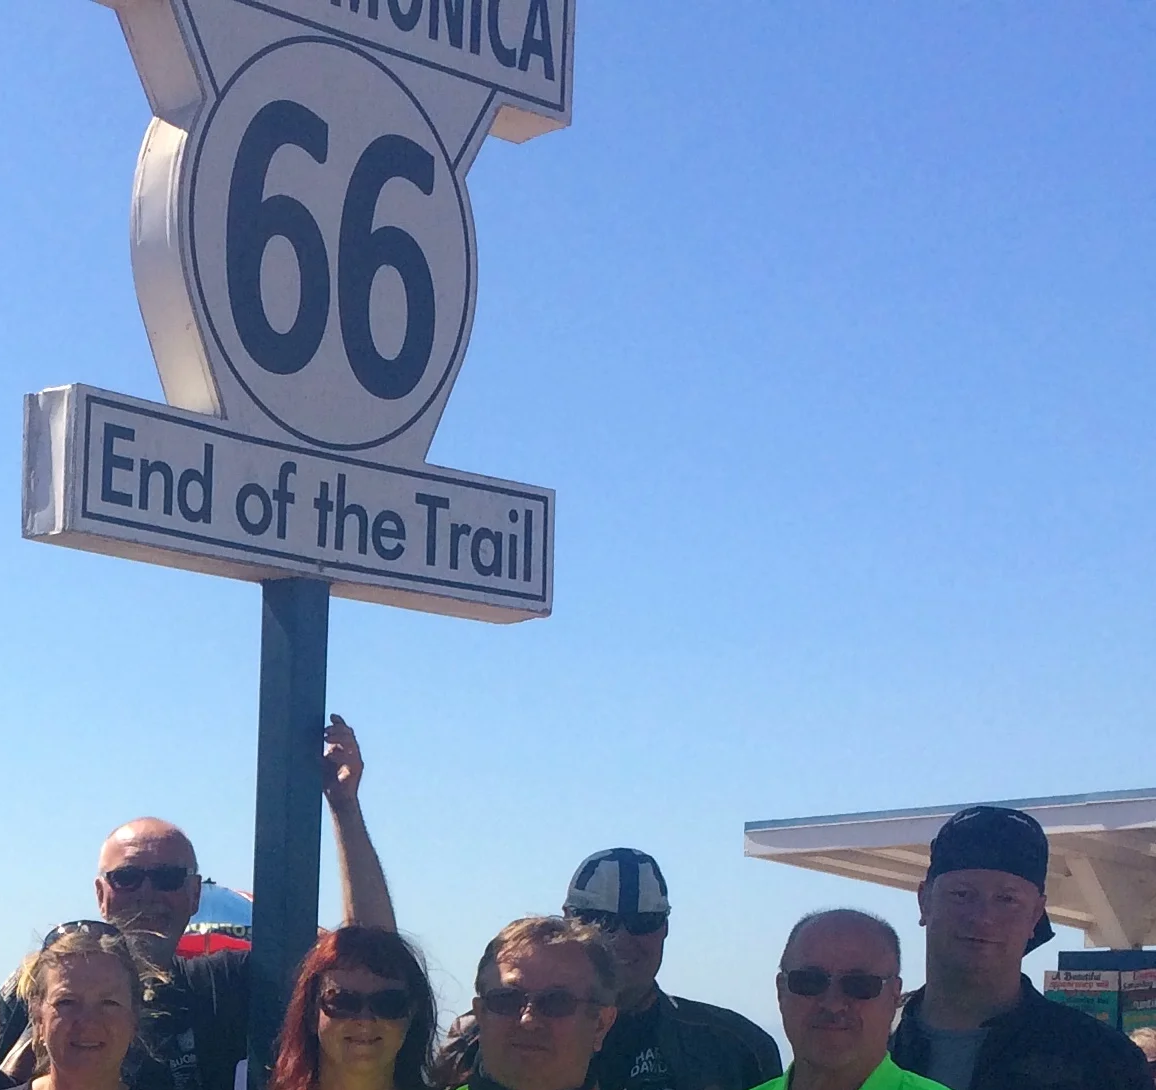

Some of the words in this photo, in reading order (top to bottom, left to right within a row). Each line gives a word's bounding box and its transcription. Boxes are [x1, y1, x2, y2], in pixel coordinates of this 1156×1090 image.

[226, 99, 436, 400] 66
[101, 422, 214, 524] End
[235, 462, 297, 540] of
[313, 474, 406, 560] the
[415, 493, 533, 583] Trail
